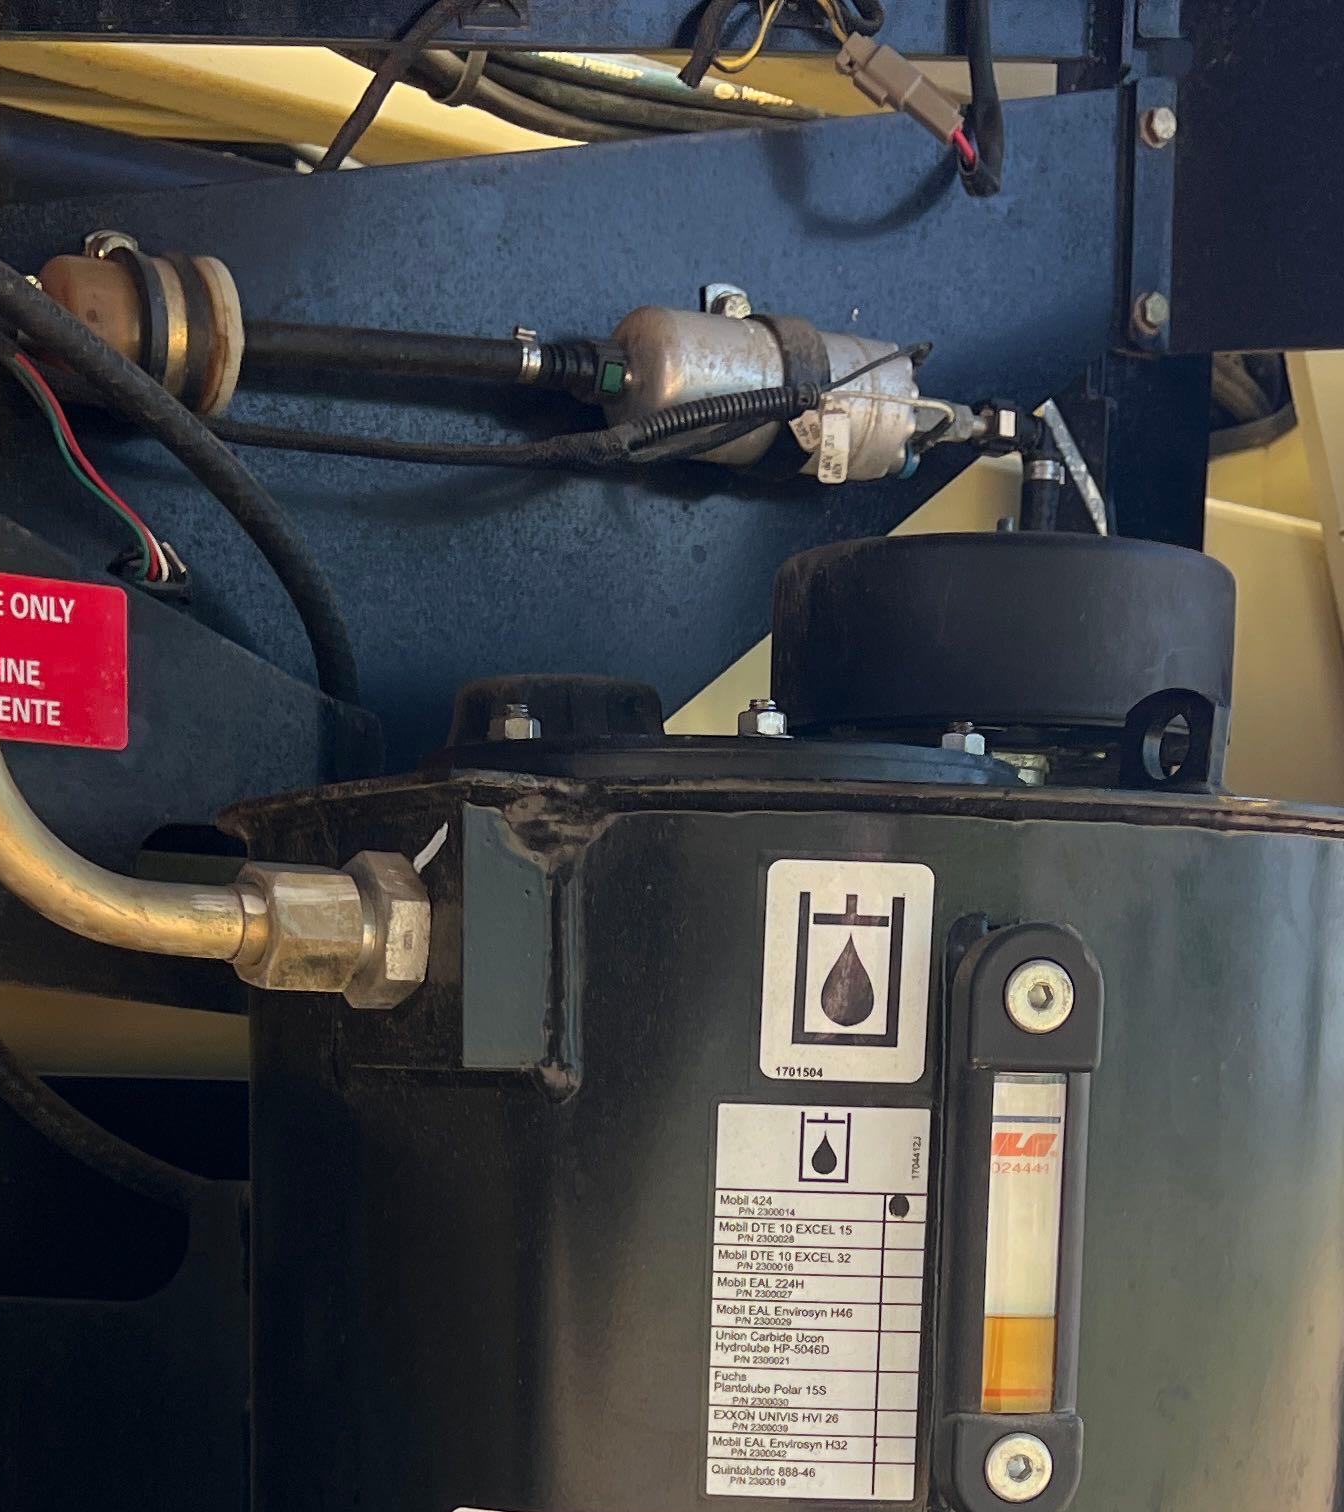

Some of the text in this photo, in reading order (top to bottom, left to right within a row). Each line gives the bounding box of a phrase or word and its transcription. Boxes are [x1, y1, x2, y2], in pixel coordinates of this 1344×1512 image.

[10, 592, 76, 624] ONLY
[775, 1066, 824, 1079] 1701504
[719, 1195, 773, 1206] Mobil 424
[738, 1207, 755, 1216] P/N
[719, 1221, 853, 1236] Mobil DTE 10 EXCEL 15
[737, 1233, 754, 1243] P/N
[718, 1249, 852, 1263] Mobil DTE 10 EXCEL 32
[736, 1261, 753, 1270] P/N
[717, 1277, 805, 1289] Mobil EAL 224H
[736, 1289, 752, 1298] P/N
[716, 1304, 853, 1320] Mobil EAL Envirosyn H46
[735, 1316, 751, 1325] P/N
[715, 1330, 825, 1343] Union Carbide Ucon
[715, 1342, 770, 1354] Hydrolube
[734, 1355, 750, 1364] P/N
[714, 1370, 747, 1381] Fuchs
[714, 1381, 771, 1394] Plantolube
[773, 1384, 802, 1395] Polar
[713, 1409, 756, 1420] EXXON
[758, 1411, 799, 1422] UNIVIS
[802, 1413, 822, 1423] HVI
[712, 1436, 848, 1452] Mobil EAL Envirosyn H32
[711, 1464, 816, 1478] Quintolubric 888-46
